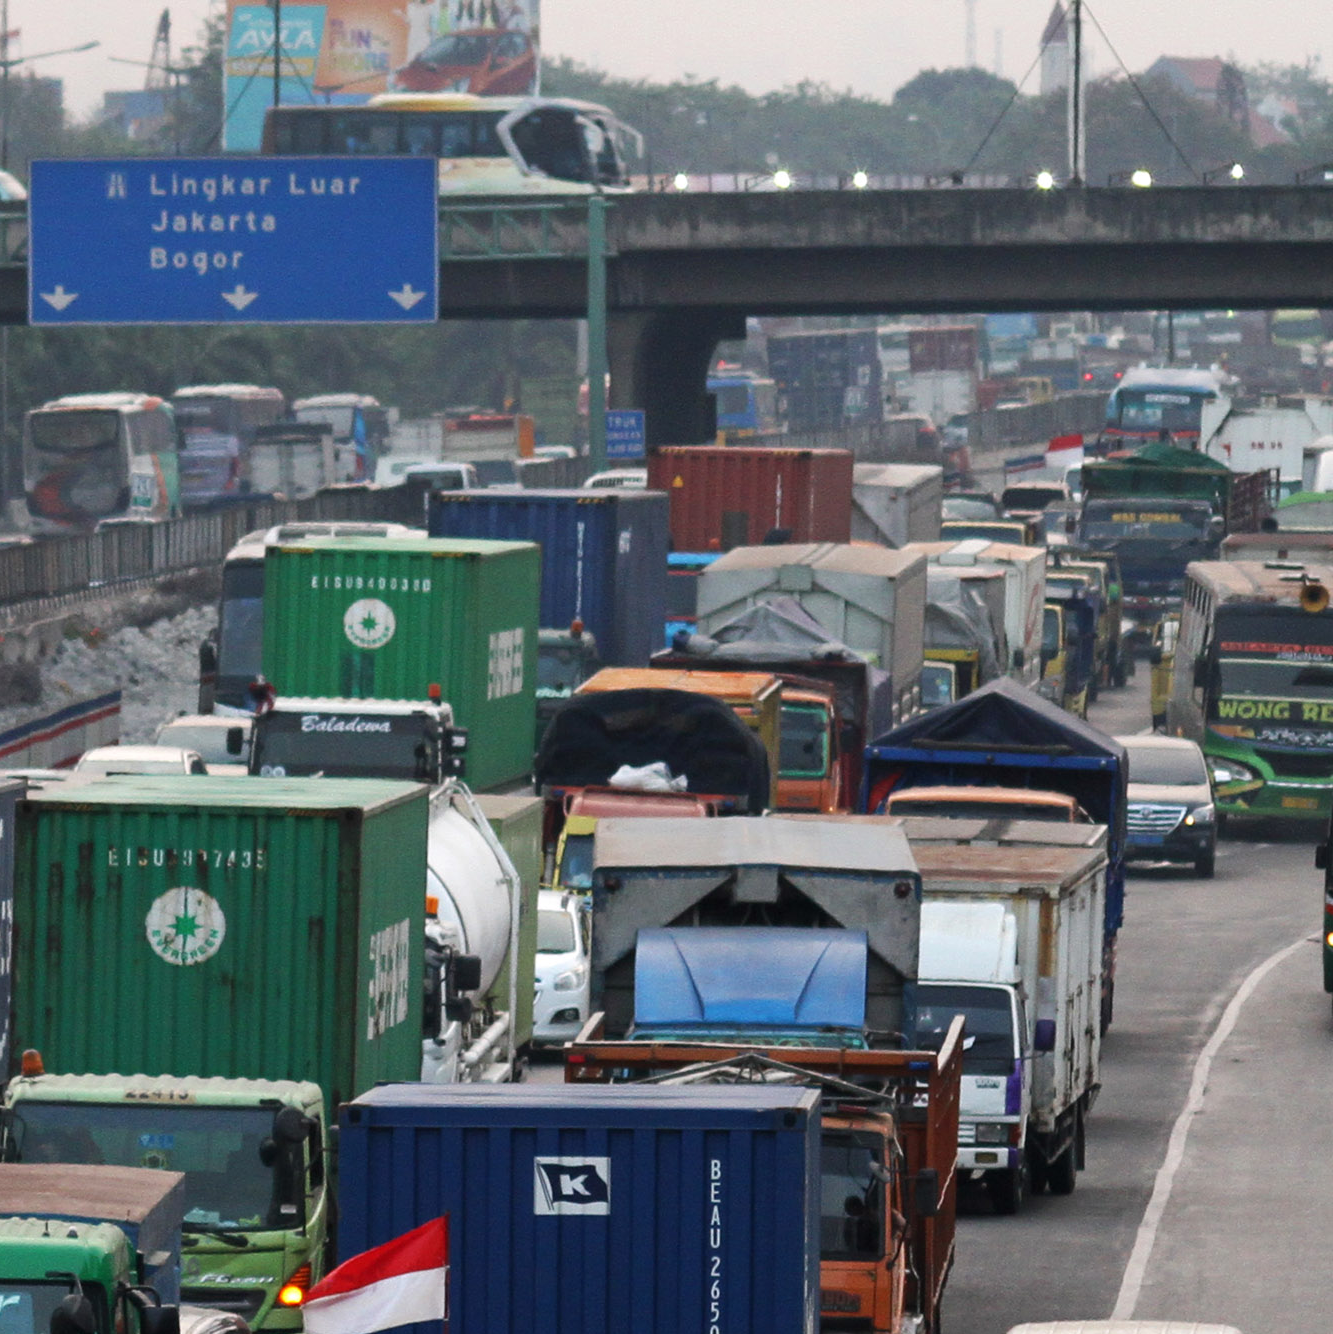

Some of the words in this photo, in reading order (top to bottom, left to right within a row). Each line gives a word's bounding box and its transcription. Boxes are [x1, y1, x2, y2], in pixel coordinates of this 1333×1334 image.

[149, 175, 271, 203] Lingkar
[288, 174, 361, 198] Luar
[152, 211, 276, 233] Jakarta
[149, 249, 245, 273] Bogor
[1218, 700, 1291, 720] WONG
[301, 715, 392, 733] Baladewa
[560, 1172, 592, 1197] K
